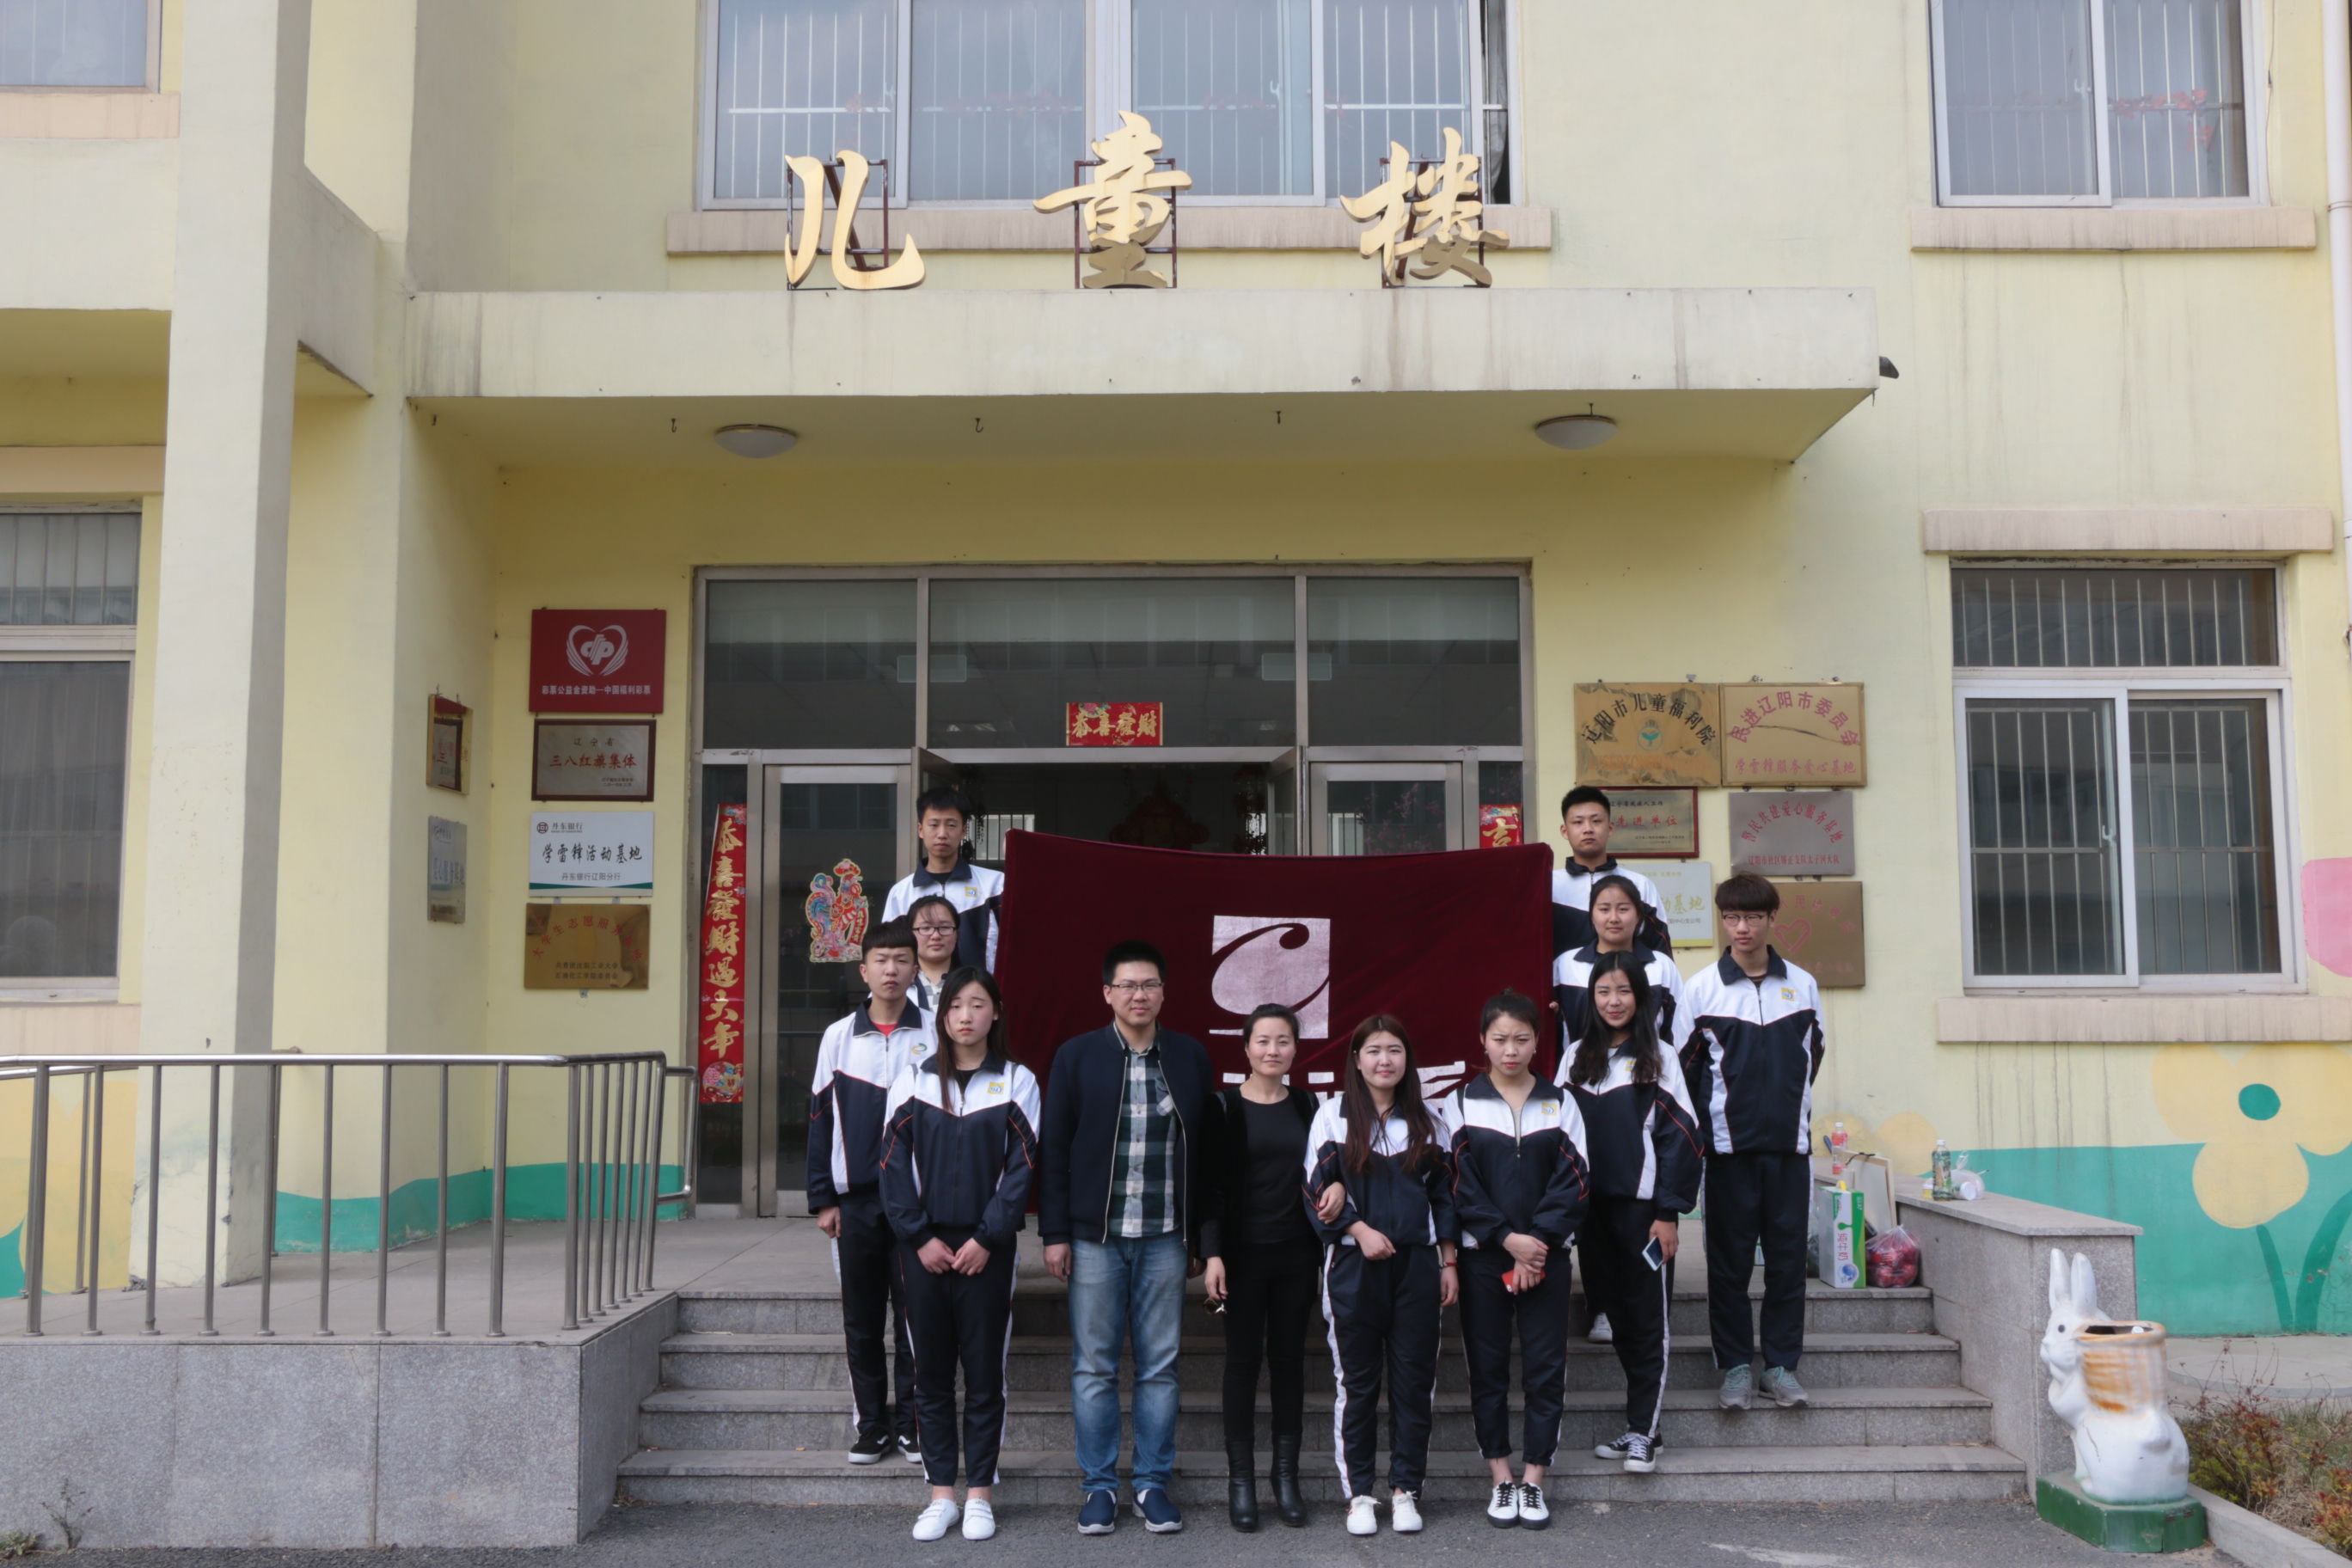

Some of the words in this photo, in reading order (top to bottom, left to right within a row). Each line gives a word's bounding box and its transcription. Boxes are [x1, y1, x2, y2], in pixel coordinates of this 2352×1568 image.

[785, 110, 1510, 289] 儿童楼
[1582, 693, 1717, 746] 辽阳市儿童福利院
[1730, 690, 1859, 746] 民进辽阳市委员会
[549, 753, 637, 769] 三八红旗集体
[542, 842, 643, 864] 学雷锋活动基地
